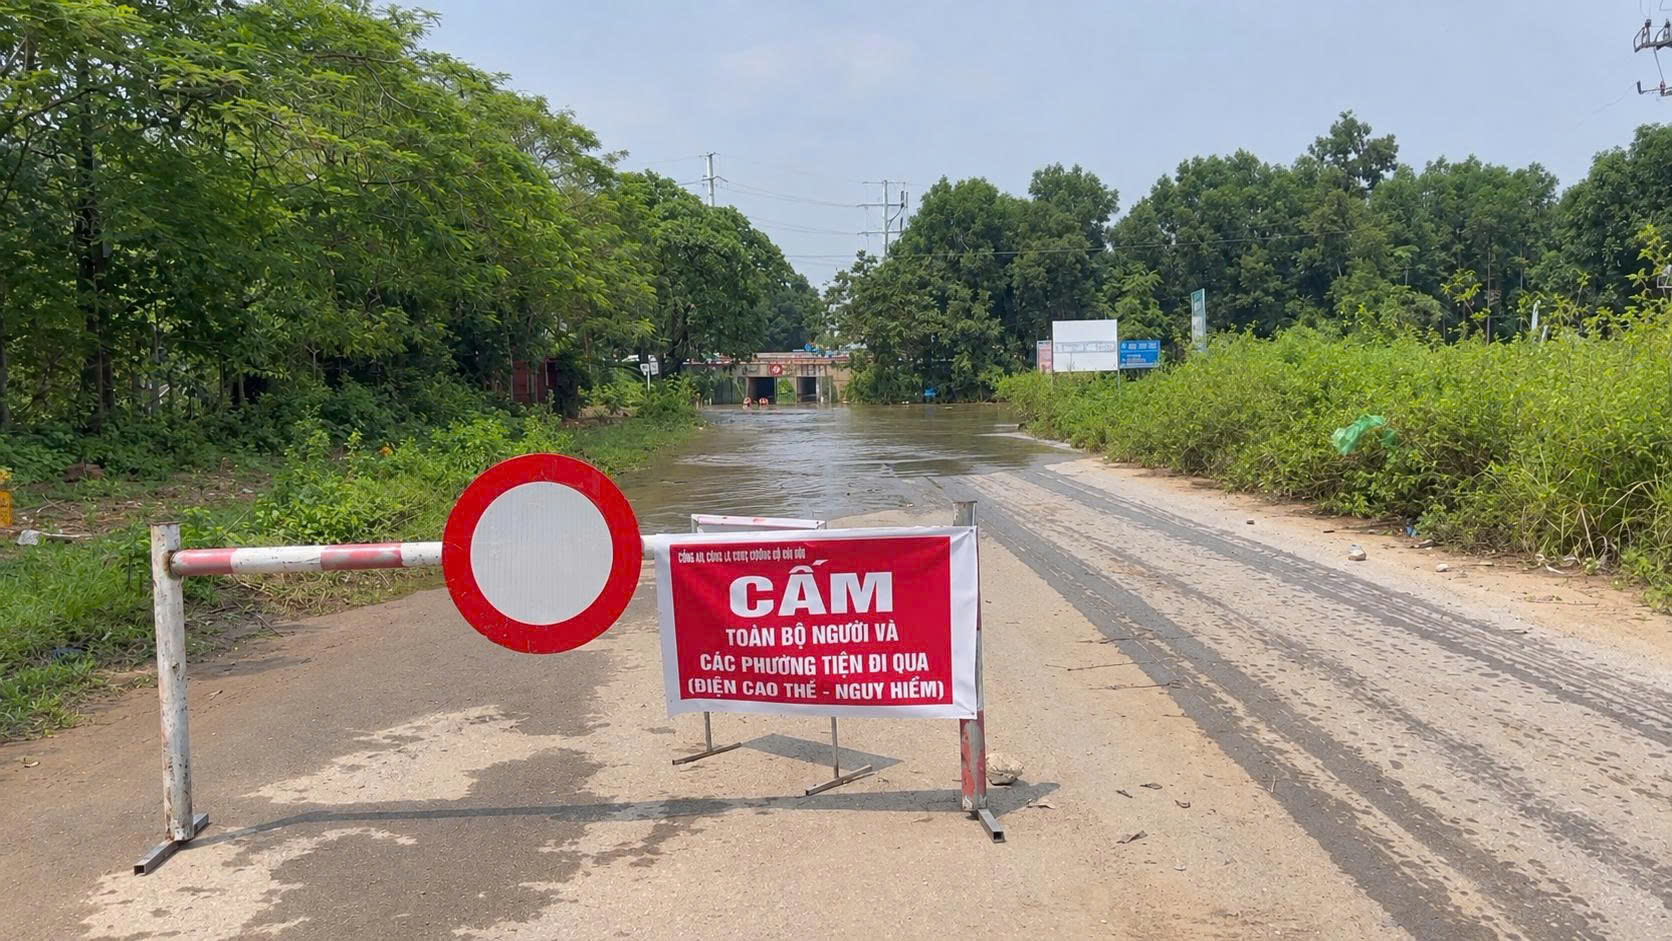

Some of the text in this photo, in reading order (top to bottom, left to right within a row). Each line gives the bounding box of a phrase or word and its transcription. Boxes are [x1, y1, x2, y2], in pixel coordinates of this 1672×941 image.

[729, 559, 893, 618] CẤM
[726, 619, 899, 649] TOÀN BỘ NGƯỜI VÀ
[700, 651, 736, 672] CÁC
[822, 651, 863, 678] TIỆN
[868, 653, 887, 673] ĐI
[893, 652, 929, 674] QUA
[688, 676, 737, 697] (ĐIỆN
[743, 681, 778, 697] CAO
[836, 682, 884, 700] NGUY
